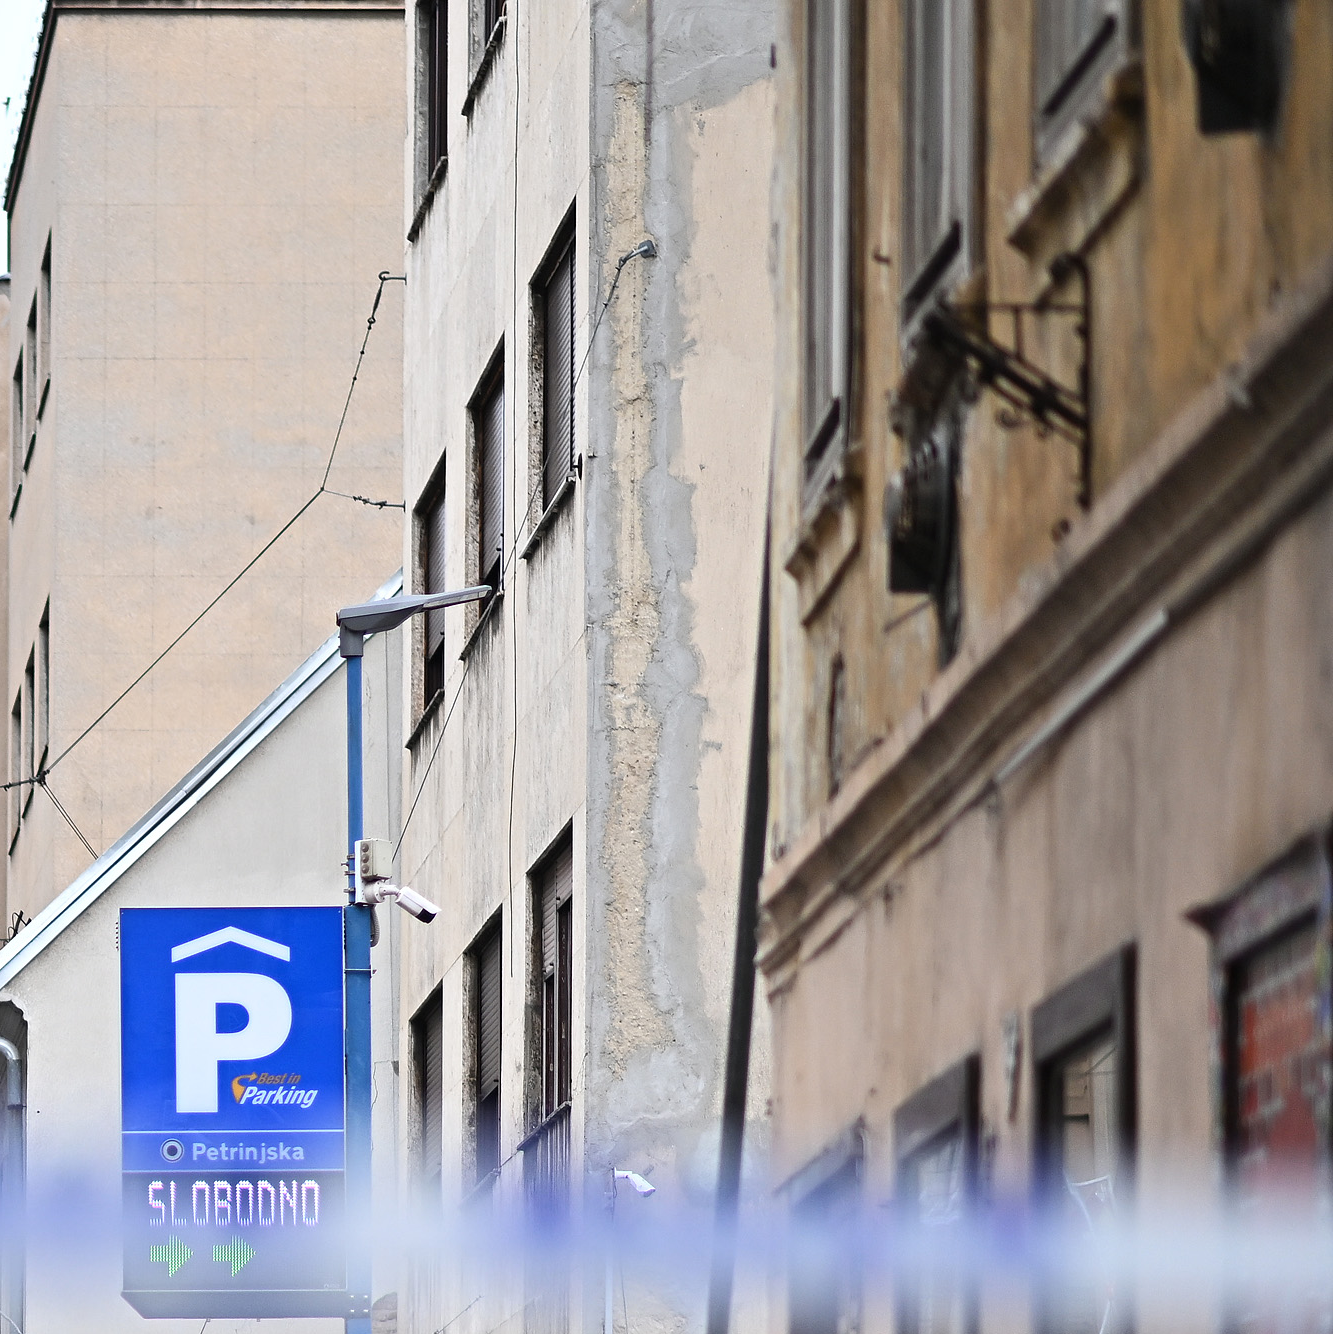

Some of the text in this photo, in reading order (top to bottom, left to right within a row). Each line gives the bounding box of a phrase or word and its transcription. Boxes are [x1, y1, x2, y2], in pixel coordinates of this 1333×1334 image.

[174, 972, 293, 1113] P
[257, 1072, 301, 1084] Best in
[240, 1086, 318, 1108] Parking
[192, 1142, 304, 1164] Petrinjska
[148, 1179, 320, 1227] SLOBODNO
